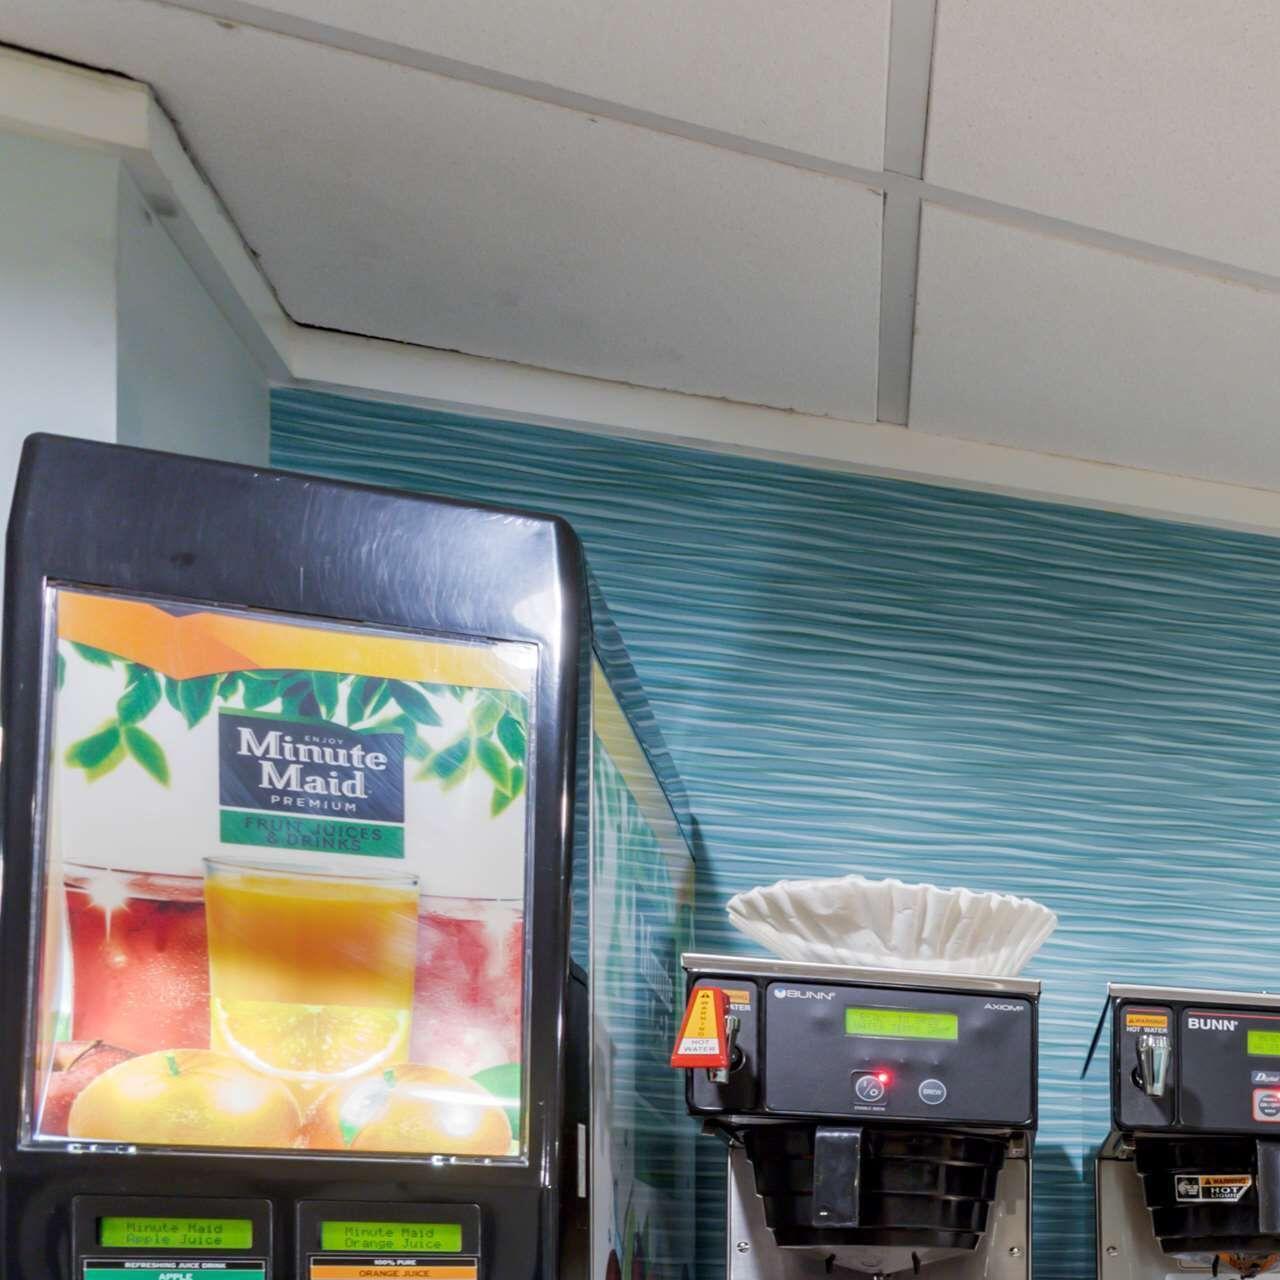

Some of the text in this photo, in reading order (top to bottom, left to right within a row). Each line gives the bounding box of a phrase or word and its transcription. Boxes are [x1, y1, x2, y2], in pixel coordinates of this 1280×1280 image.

[305, 735, 344, 745] ENJOY
[237, 726, 388, 770] Minute
[258, 760, 368, 798] Maid
[271, 795, 357, 812] PREMIUM
[244, 817, 383, 840] FRUIT JUICES
[287, 834, 362, 851] DRINKS
[786, 990, 831, 1000] BUNN
[1188, 1018, 1235, 1031] BUNN
[126, 1222, 224, 1233] Minute Maid
[345, 1227, 435, 1238] Minute Maid
[126, 1234, 223, 1245] Apple Juice
[345, 1238, 441, 1249] Orange Juice
[158, 1273, 193, 1280] APPLE
